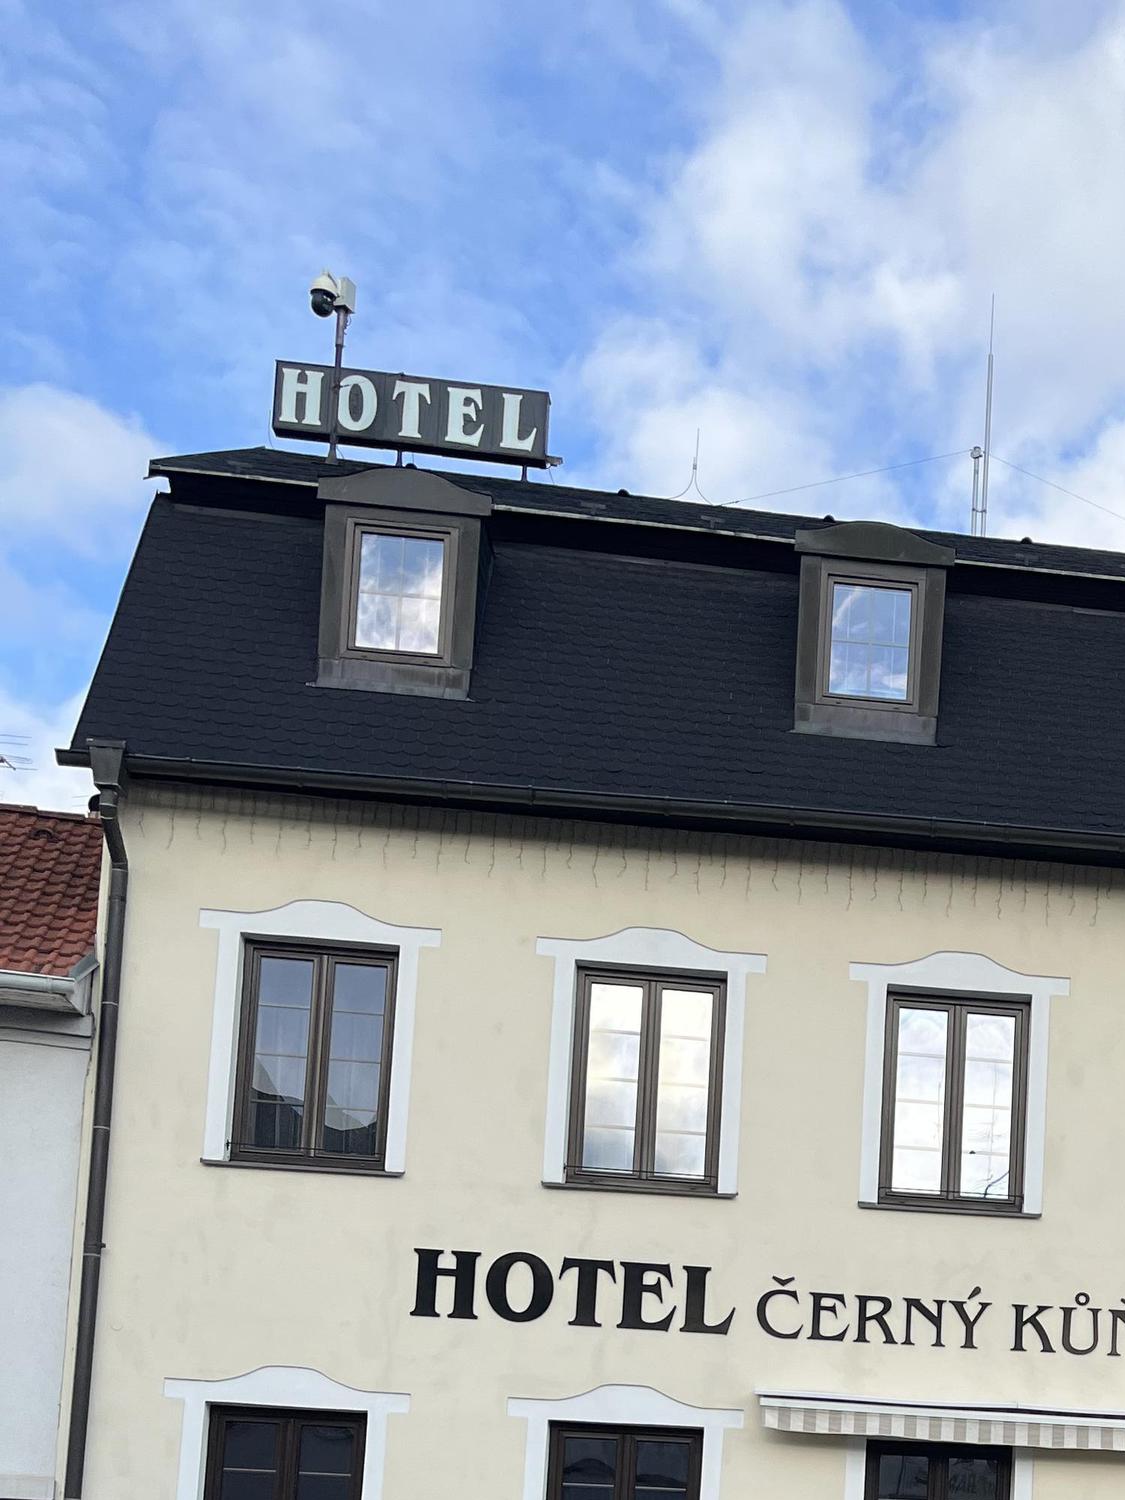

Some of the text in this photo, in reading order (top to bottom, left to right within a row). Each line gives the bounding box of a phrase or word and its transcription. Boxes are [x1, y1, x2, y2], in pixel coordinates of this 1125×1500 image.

[278, 367, 537, 452] HOTEL
[409, 1247, 736, 1336] HOTEL
[756, 1275, 993, 1350] ČERNÝ
